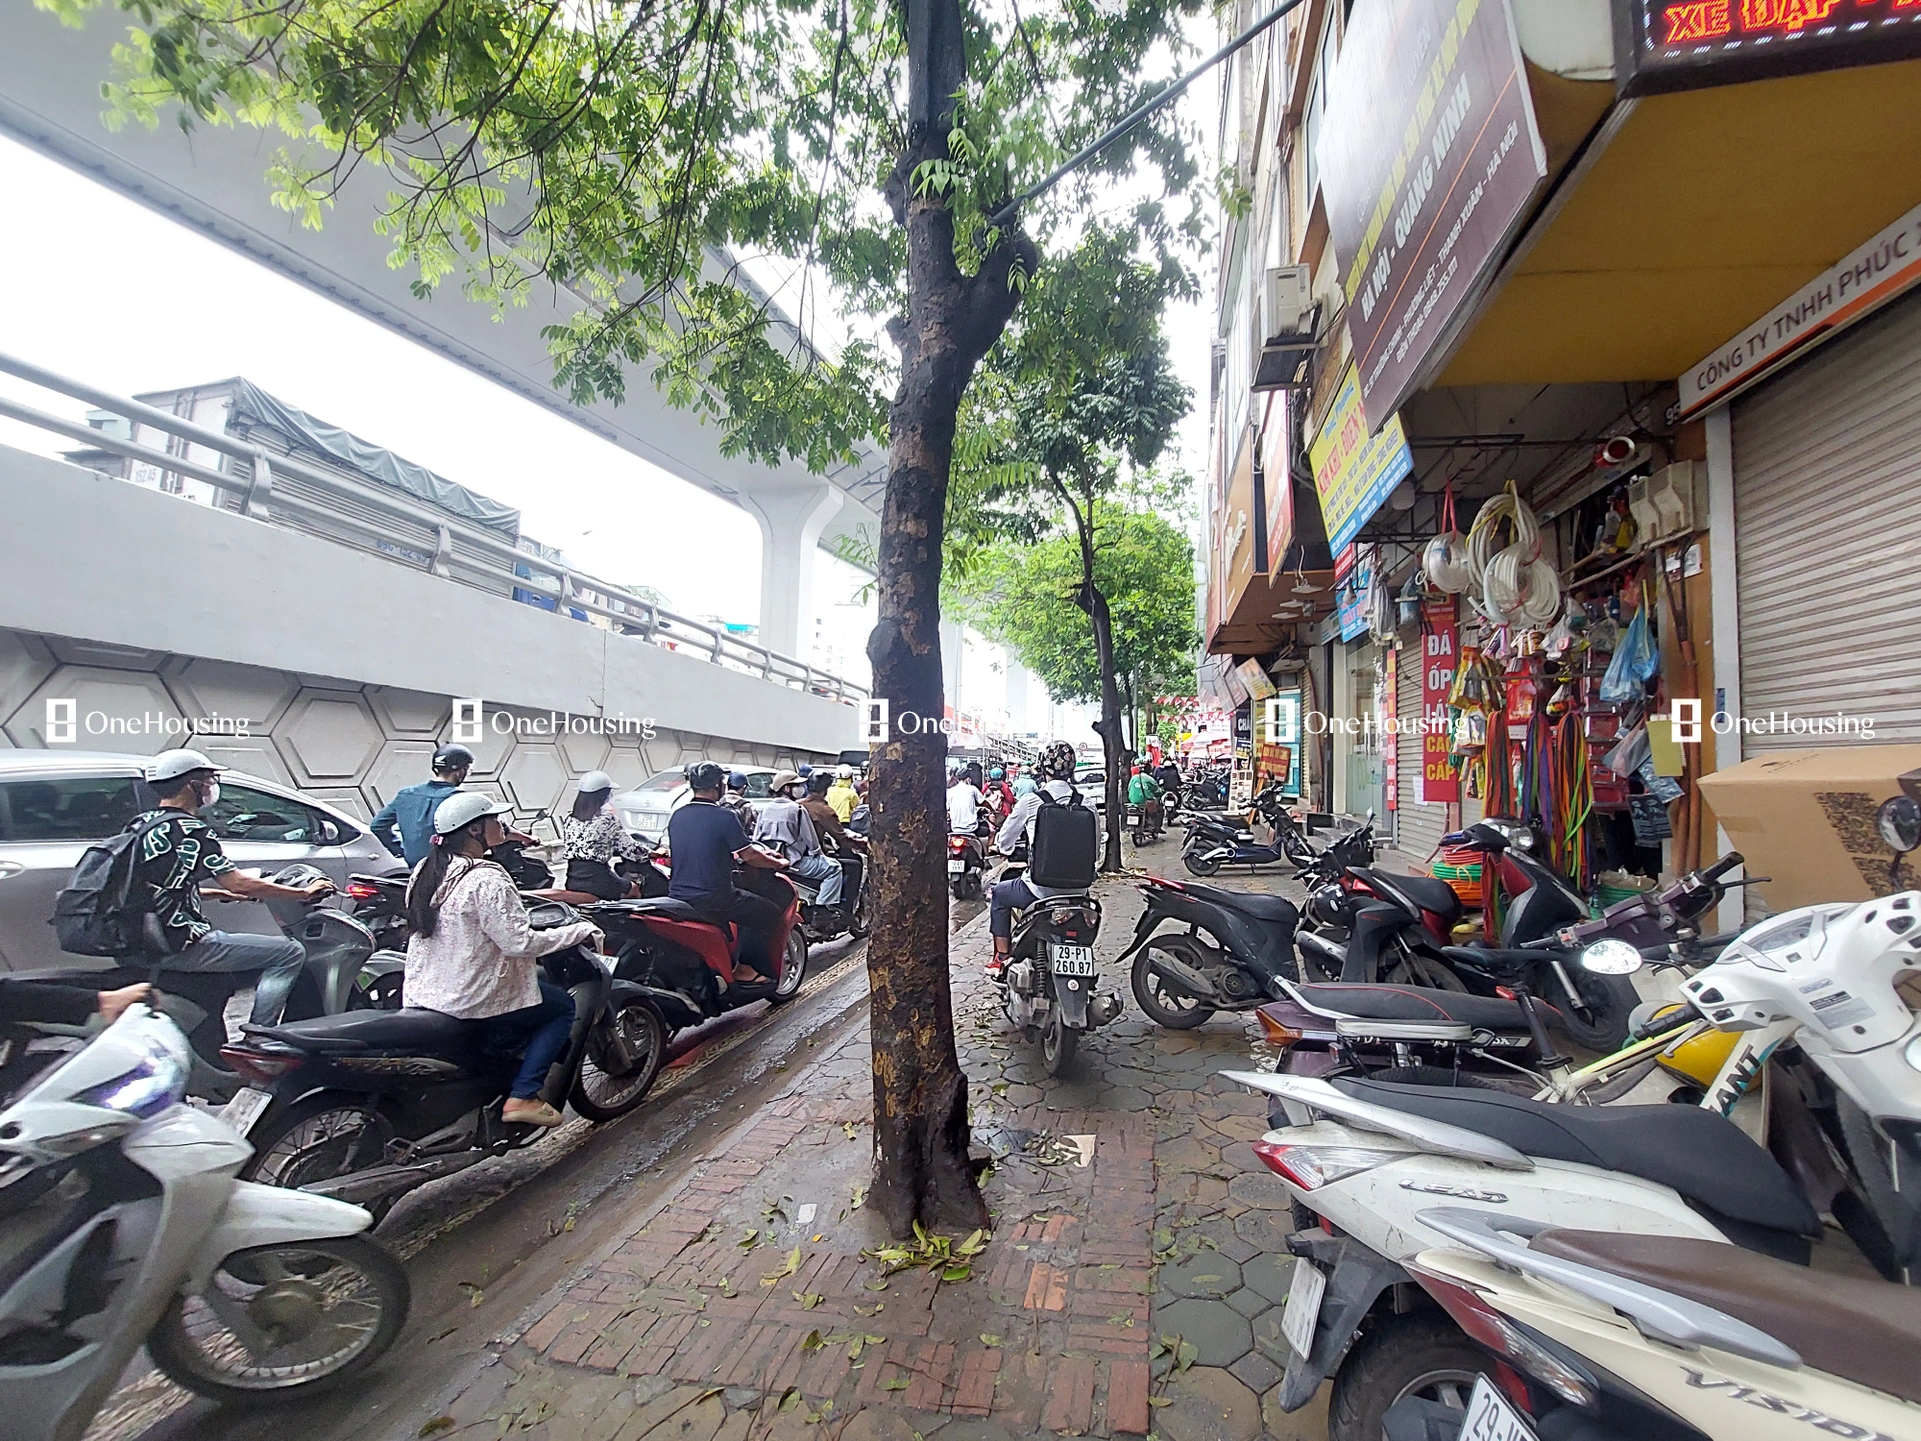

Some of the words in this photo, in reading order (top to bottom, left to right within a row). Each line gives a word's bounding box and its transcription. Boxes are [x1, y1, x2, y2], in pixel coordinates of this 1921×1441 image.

[1664, 0, 1731, 43] XE
[1361, 280, 1376, 323] HÀ
[1371, 246, 1391, 301] NỘI
[1394, 154, 1434, 250] QUẢNG
[1431, 71, 1472, 172] NINH
[1697, 347, 1743, 391] CÔNG
[1747, 328, 1768, 357] TY
[1774, 284, 1832, 339] TNHH
[1839, 231, 1909, 297] PHÚC
[1428, 630, 1451, 656] ĐÁ
[1428, 661, 1451, 690] ỐP
[1426, 758, 1455, 781] CẤP
[1059, 946, 1087, 960] 29-P1
[1055, 960, 1091, 975] 260.87
[1711, 1043, 1761, 1118] ANT
[1398, 1179, 1509, 1204] LEAD
